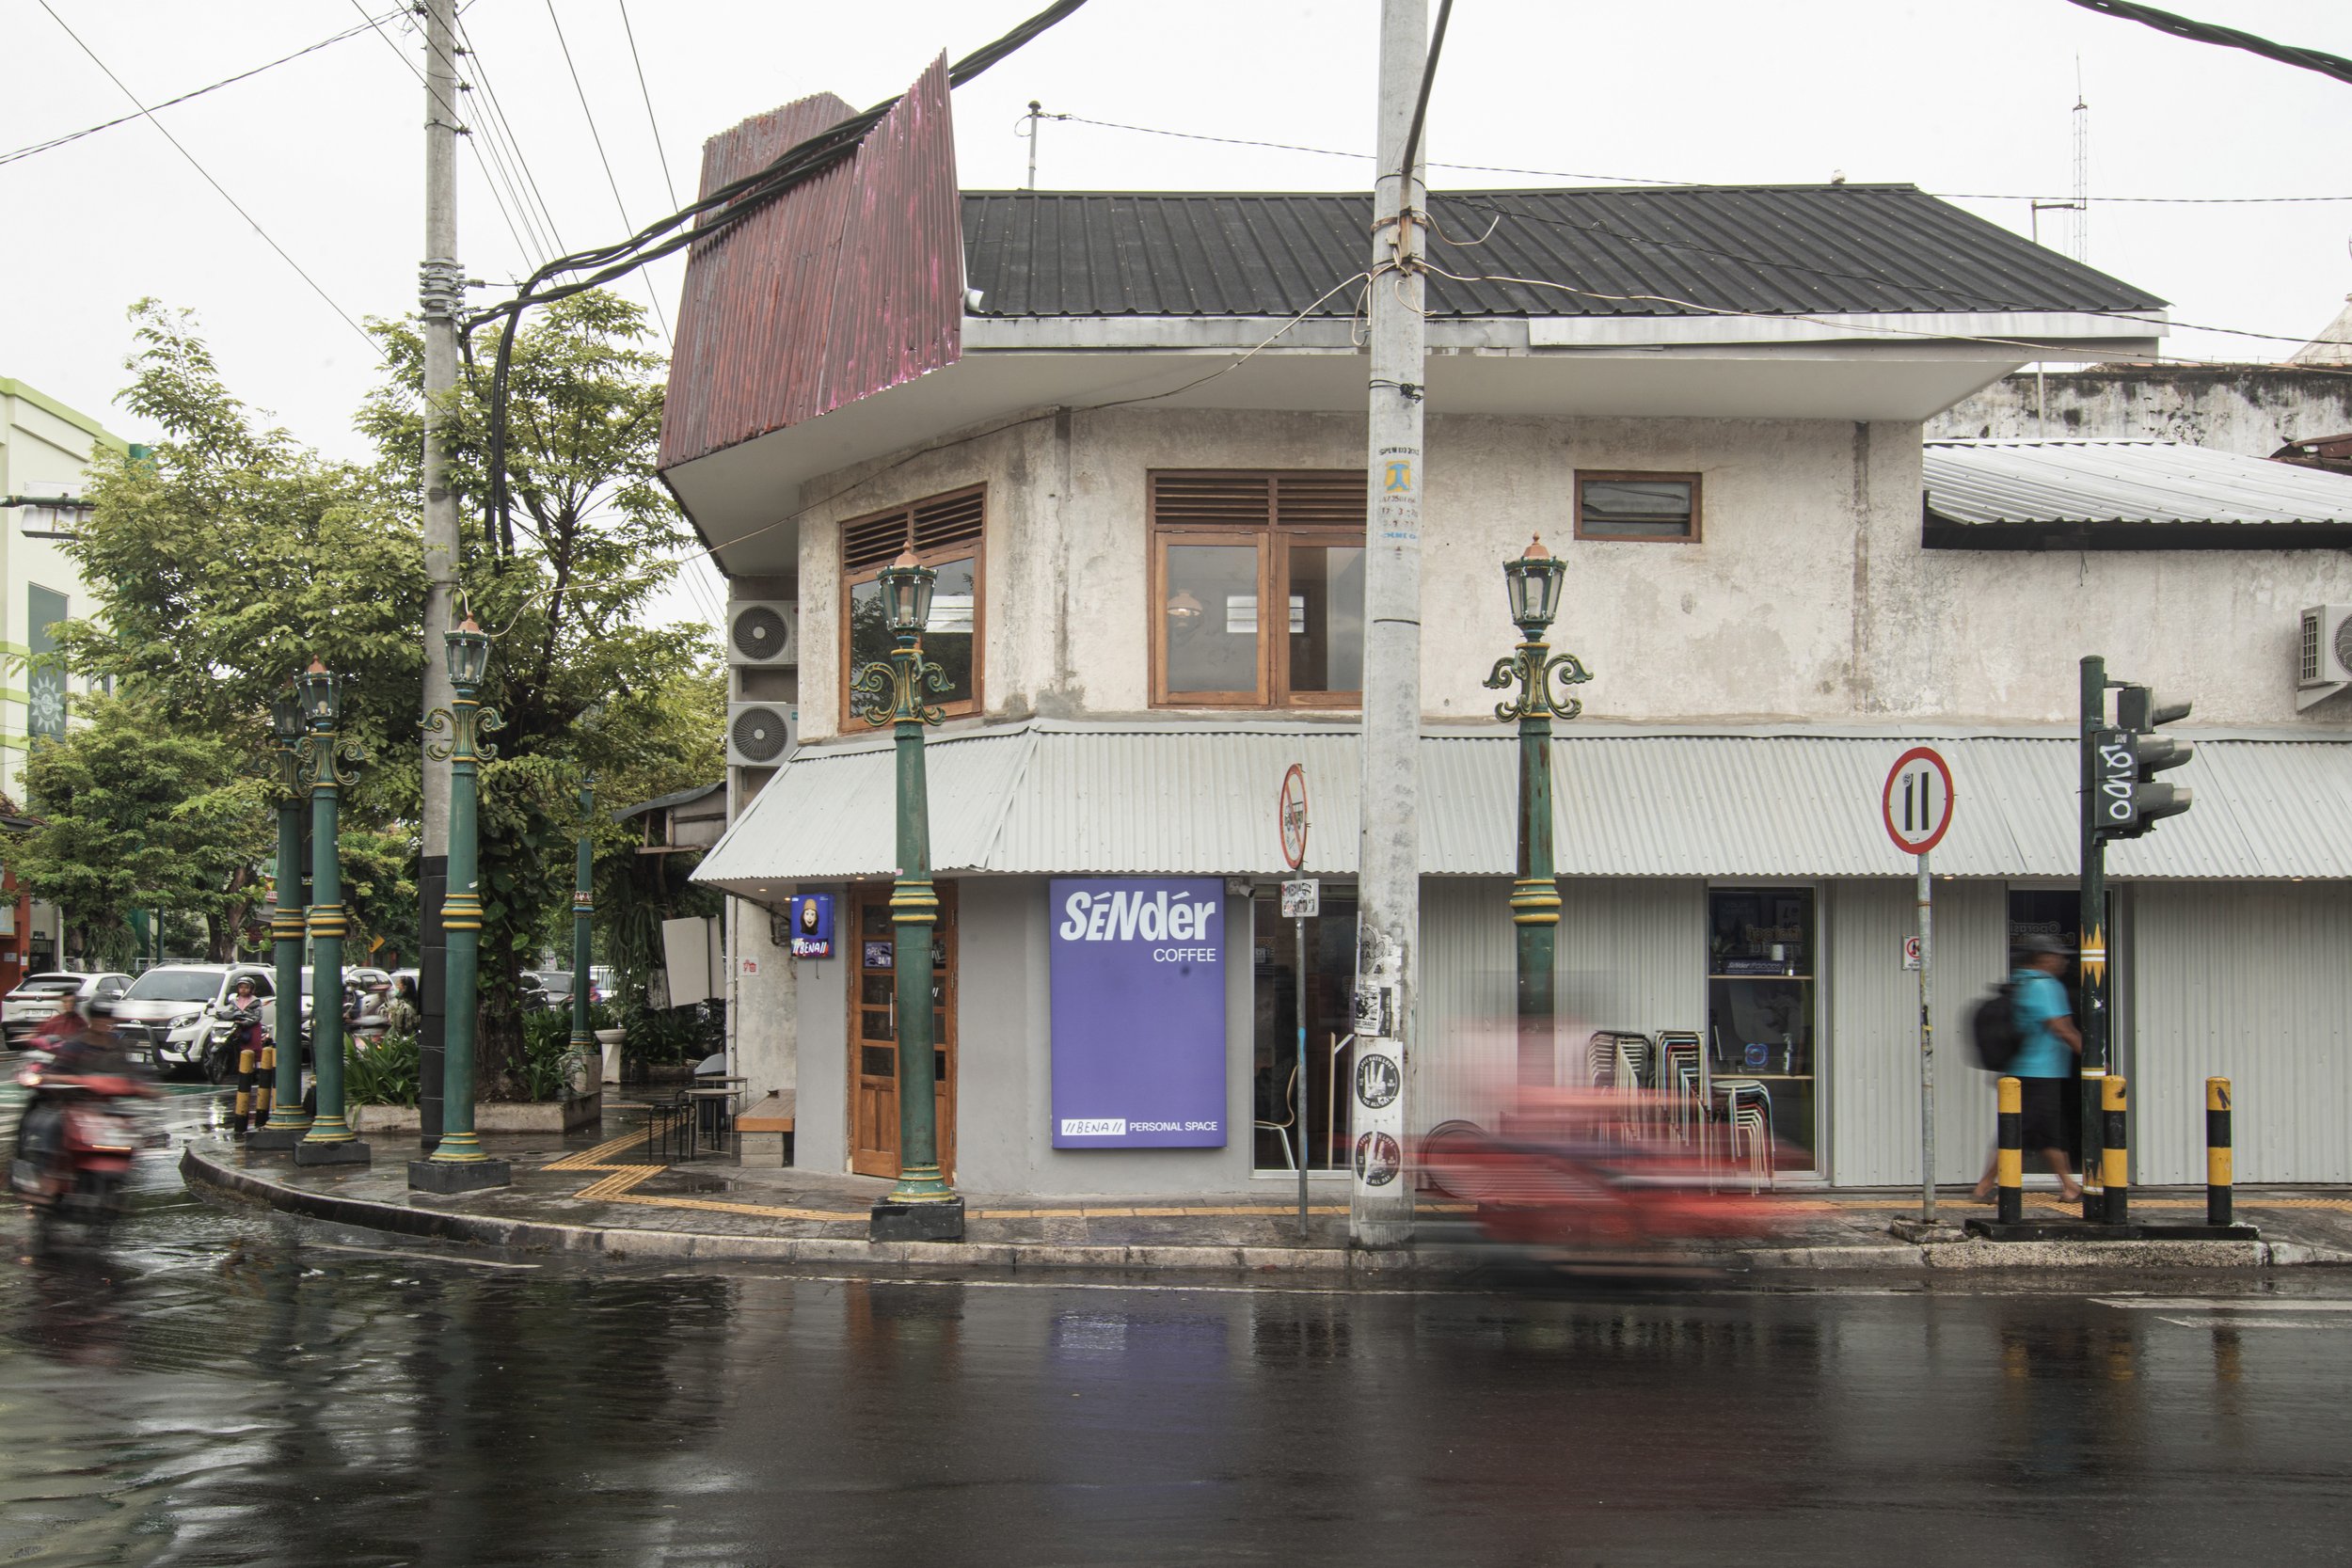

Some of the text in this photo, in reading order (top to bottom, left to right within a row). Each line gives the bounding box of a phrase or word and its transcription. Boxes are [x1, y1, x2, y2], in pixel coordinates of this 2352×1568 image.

[1153, 948, 1216, 962] COFFEE
[1382, 1058, 1395, 1070] LOVE
[1129, 1122, 1183, 1132] PERSONAL
[1185, 1121, 1218, 1131] SPACE
